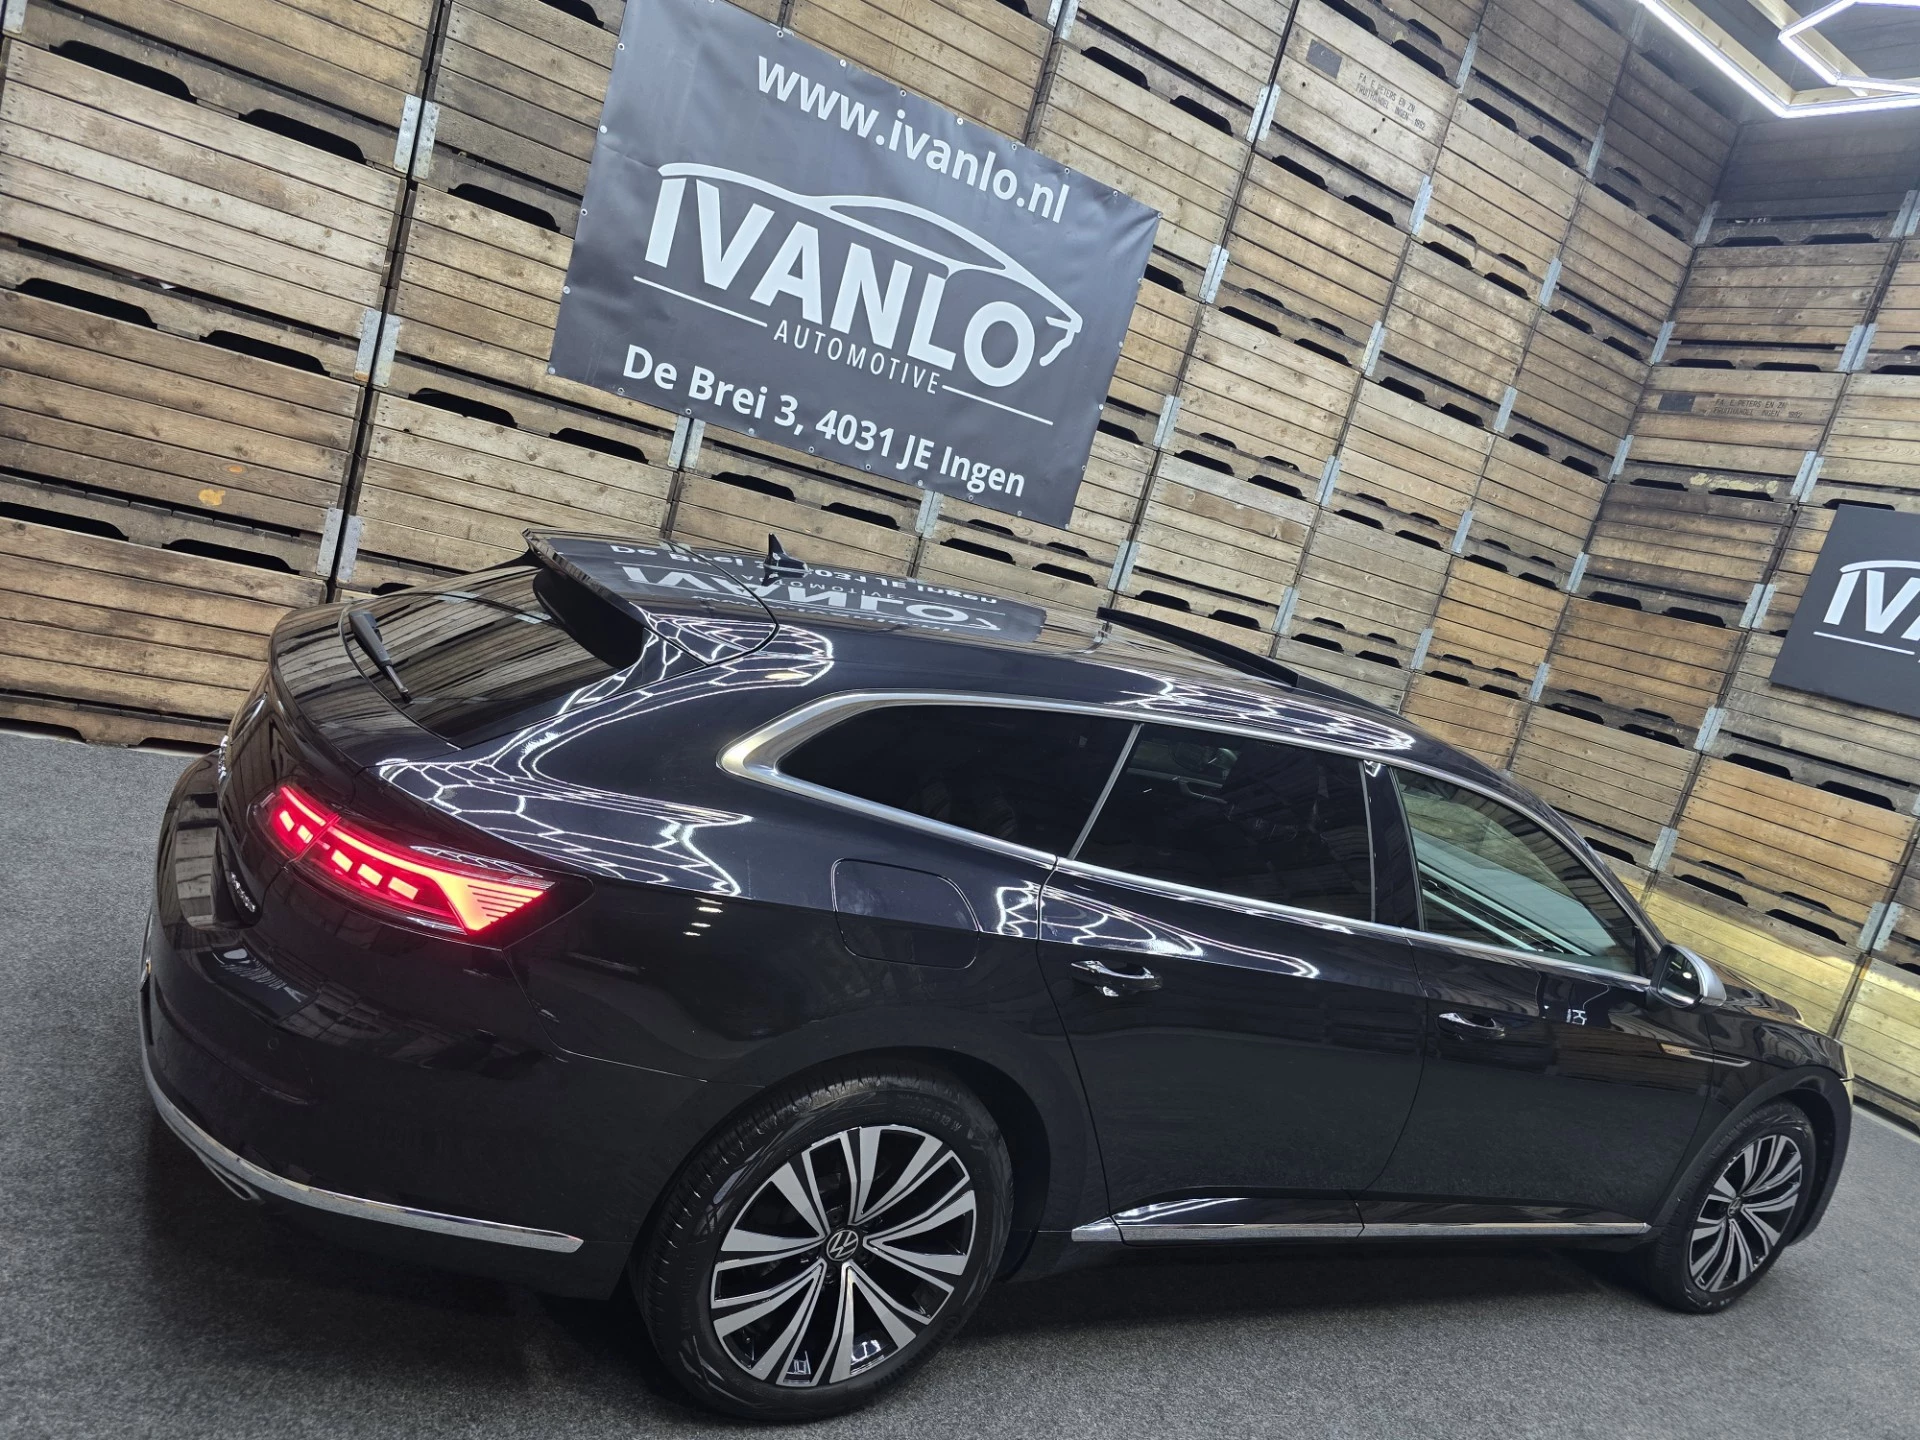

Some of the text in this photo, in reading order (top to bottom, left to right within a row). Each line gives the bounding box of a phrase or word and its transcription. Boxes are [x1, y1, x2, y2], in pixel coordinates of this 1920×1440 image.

[756, 55, 1070, 223] www.ivanlo.nl
[645, 178, 1035, 387] IVANLO
[774, 319, 939, 395] AUTOMOTIVE
[623, 344, 1026, 497] De Brei 3, 4031 JE Ingen
[1823, 570, 1920, 641] IV
